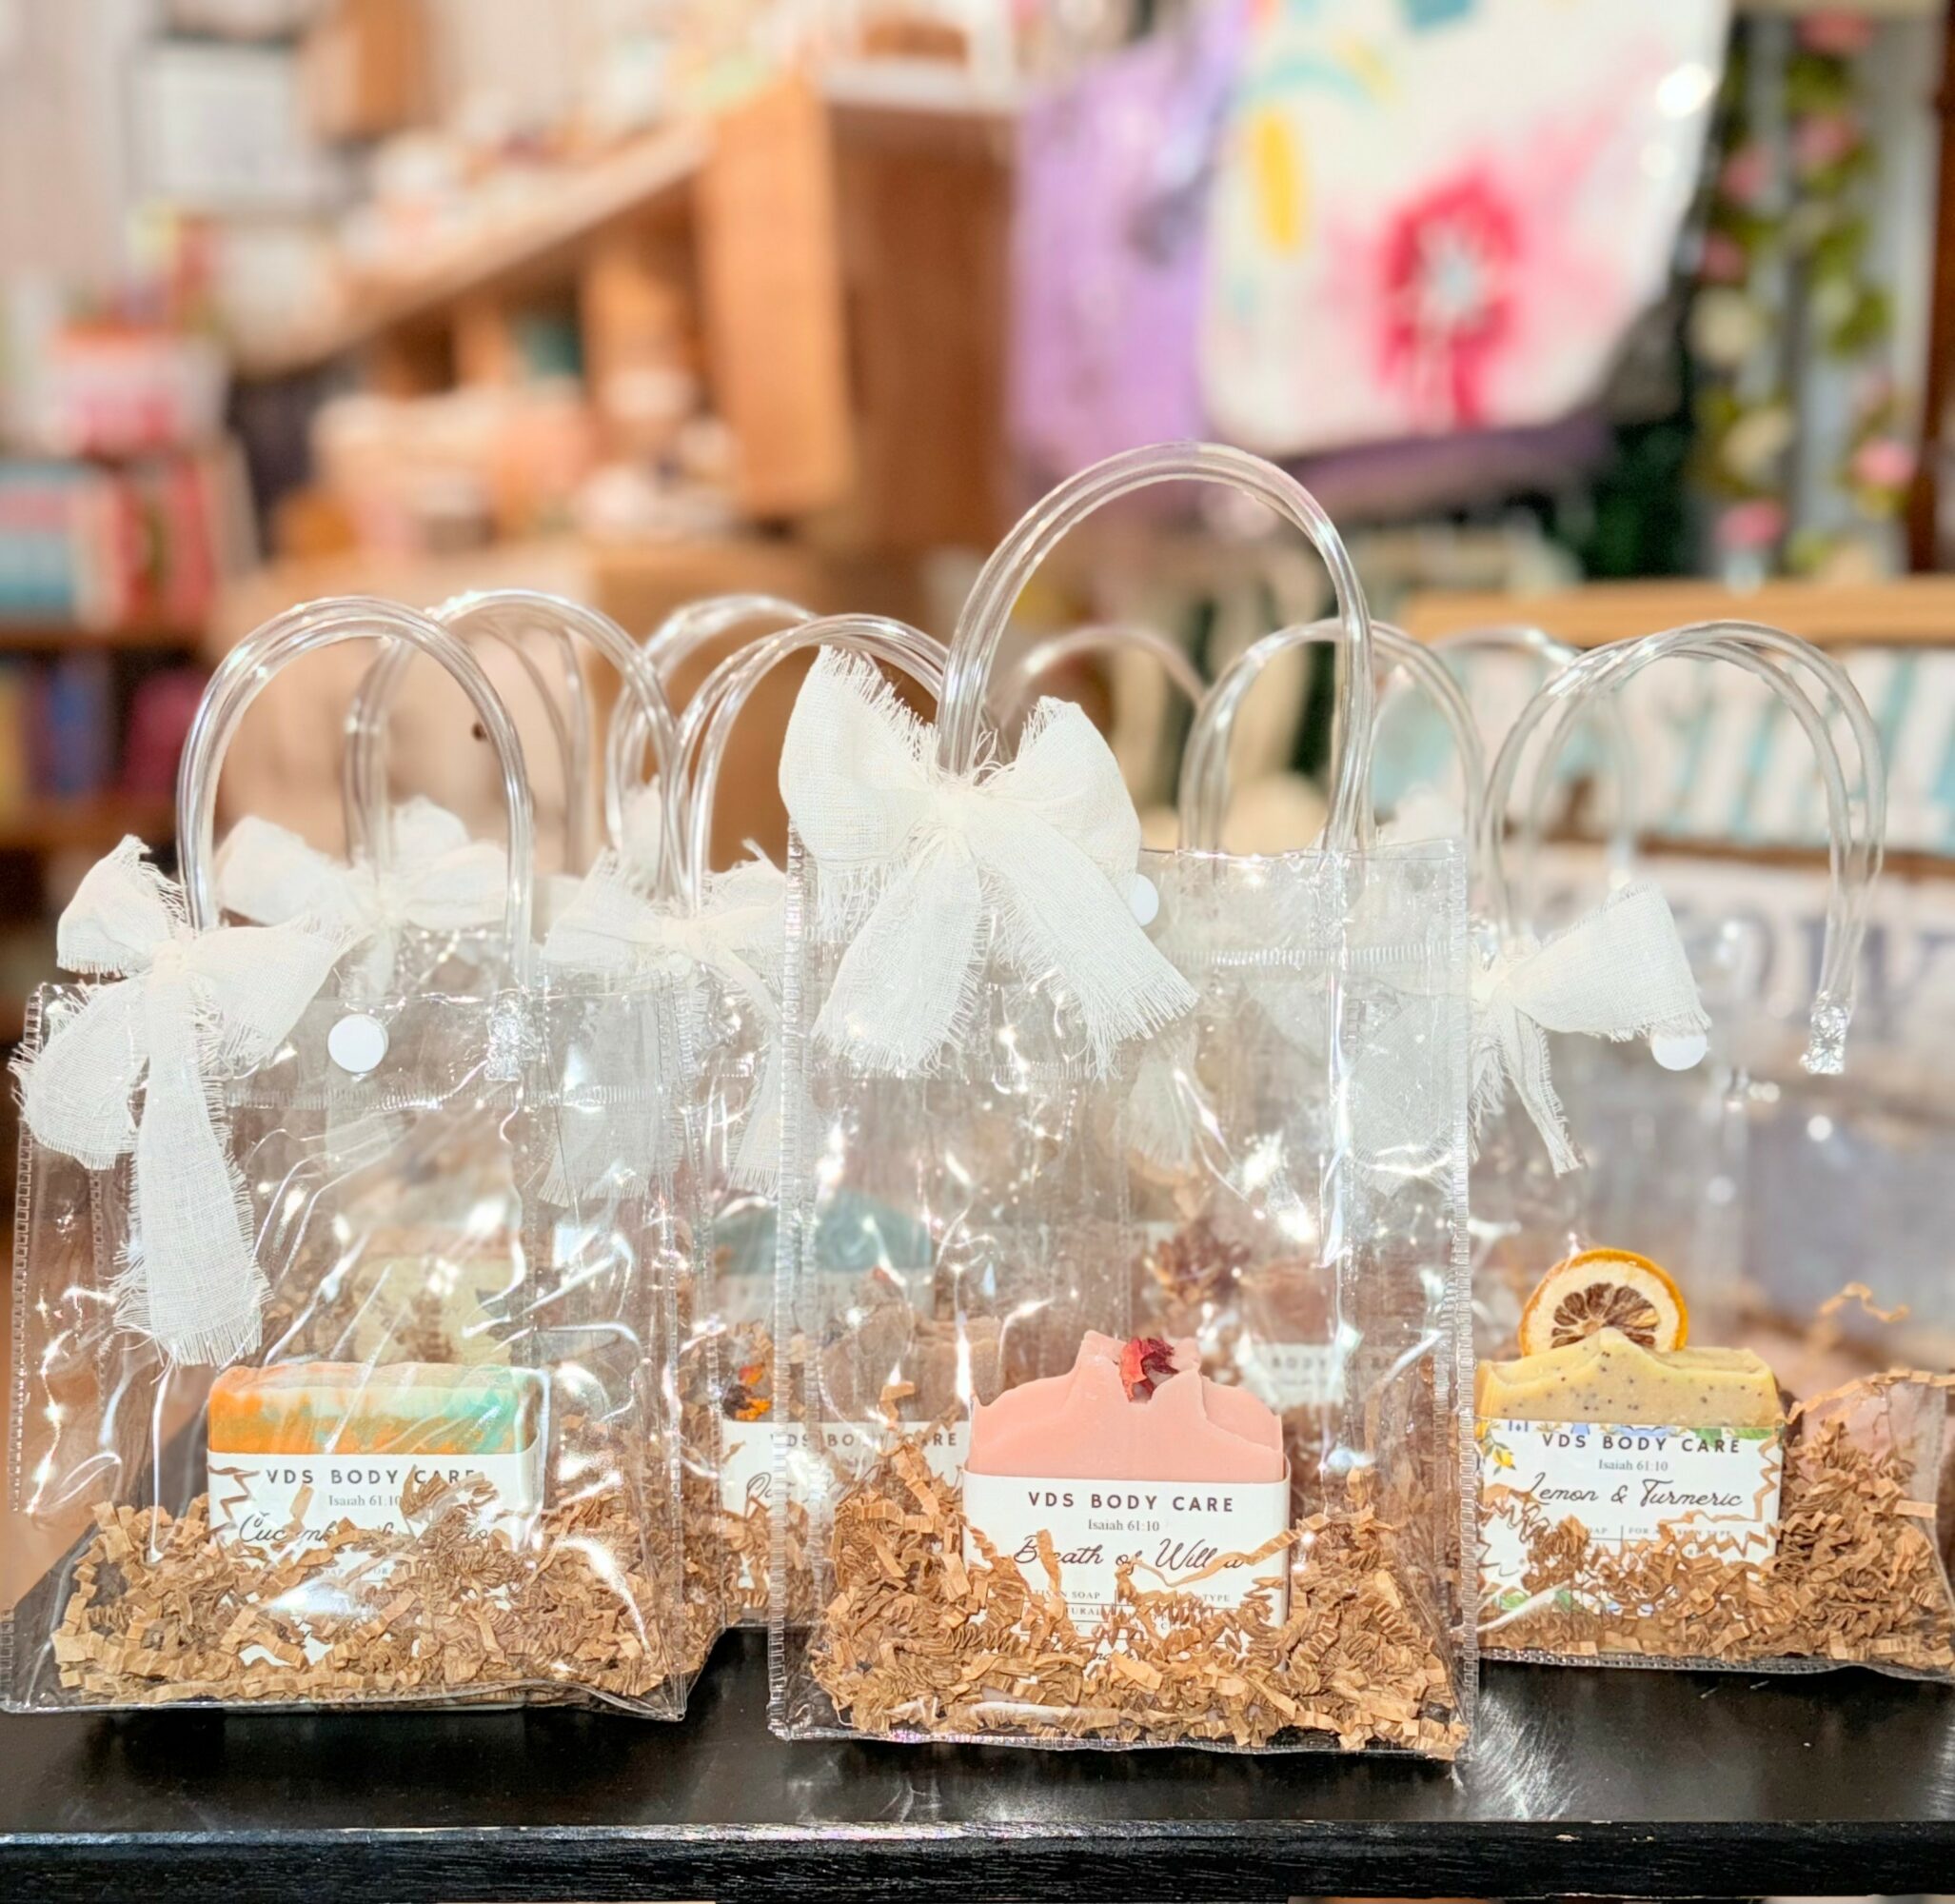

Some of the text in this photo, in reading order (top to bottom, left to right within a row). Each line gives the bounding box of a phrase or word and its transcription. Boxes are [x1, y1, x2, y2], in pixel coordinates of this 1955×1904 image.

[1542, 1434, 1740, 1453] VDS BODY CARE
[1598, 1458, 1669, 1472] Isaiah 61:10
[267, 1469, 314, 1484] VDS
[330, 1469, 399, 1484] BODY
[1530, 1472, 1744, 1508] Lemon & Turmeric
[328, 1495, 365, 1507] Isaiah
[1028, 1492, 1234, 1512] VDS BODY CARE
[1088, 1519, 1160, 1532] Isaiah 61:10
[1014, 1535, 1103, 1564] Beath
[1071, 1591, 1100, 1599] SOAP
[1202, 1594, 1230, 1602] TYPE
